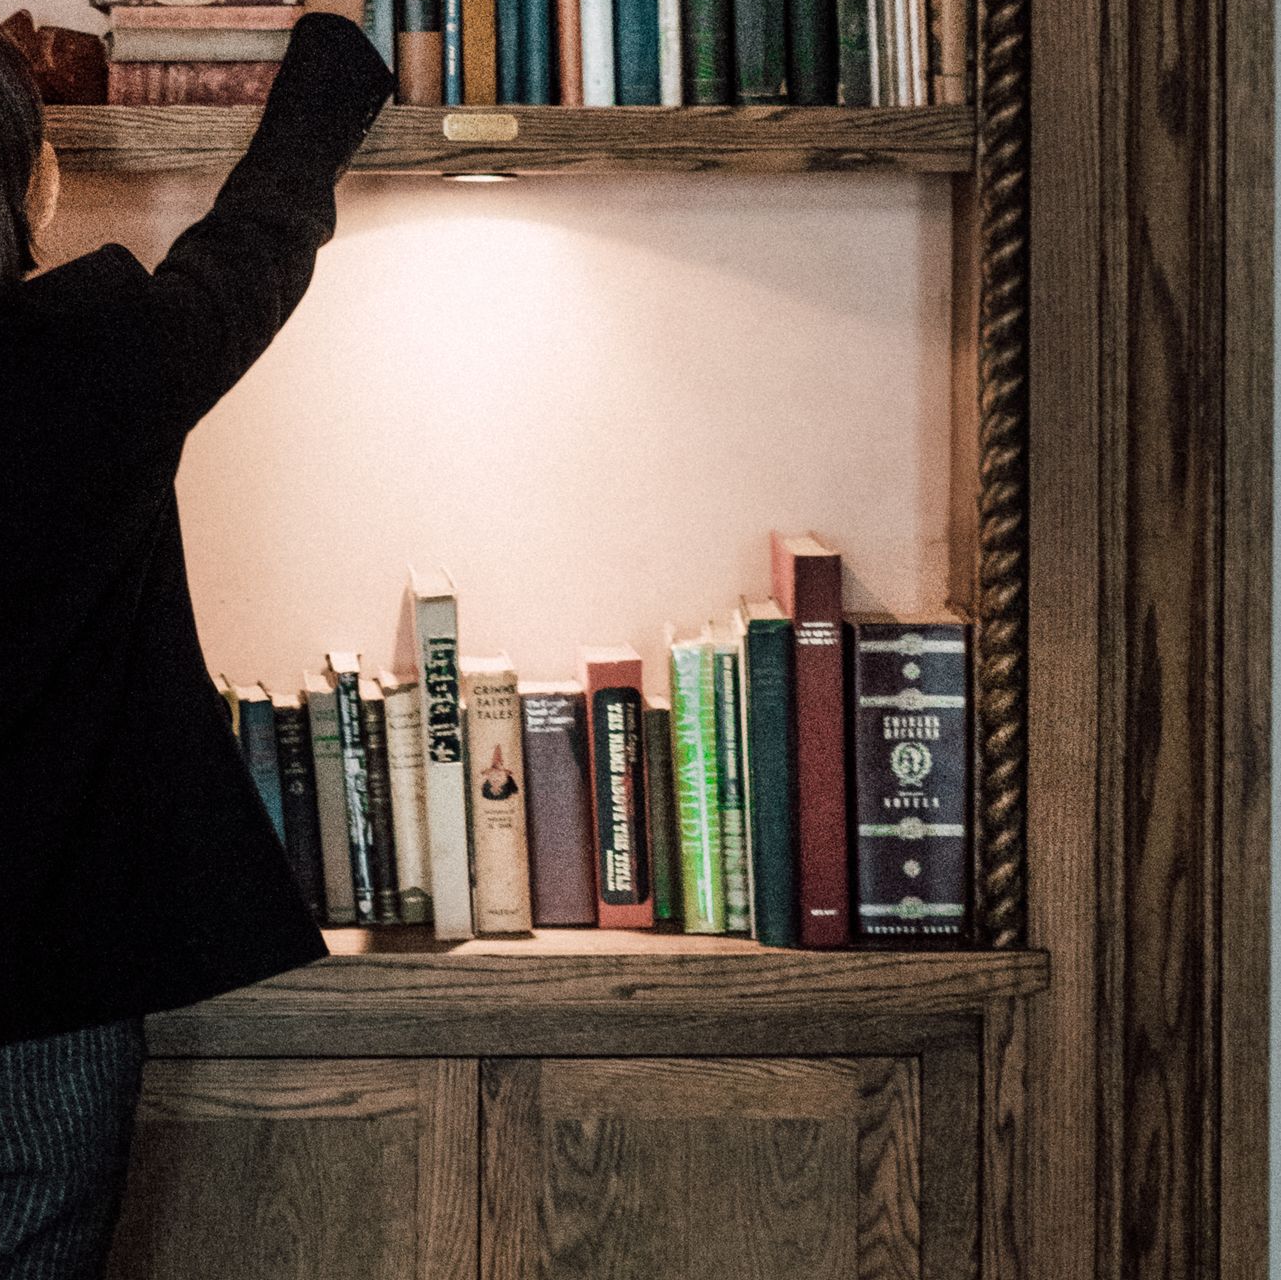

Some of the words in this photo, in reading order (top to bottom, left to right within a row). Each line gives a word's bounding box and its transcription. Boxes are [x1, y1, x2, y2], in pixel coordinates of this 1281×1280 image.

[477, 709, 514, 721] TALES
[606, 702, 625, 731] THE
[608, 732, 626, 773] NAME
[610, 774, 628, 822] ABOVE
[677, 760, 704, 856] WILDE
[612, 822, 631, 851] THE
[614, 851, 633, 892] TITLE
